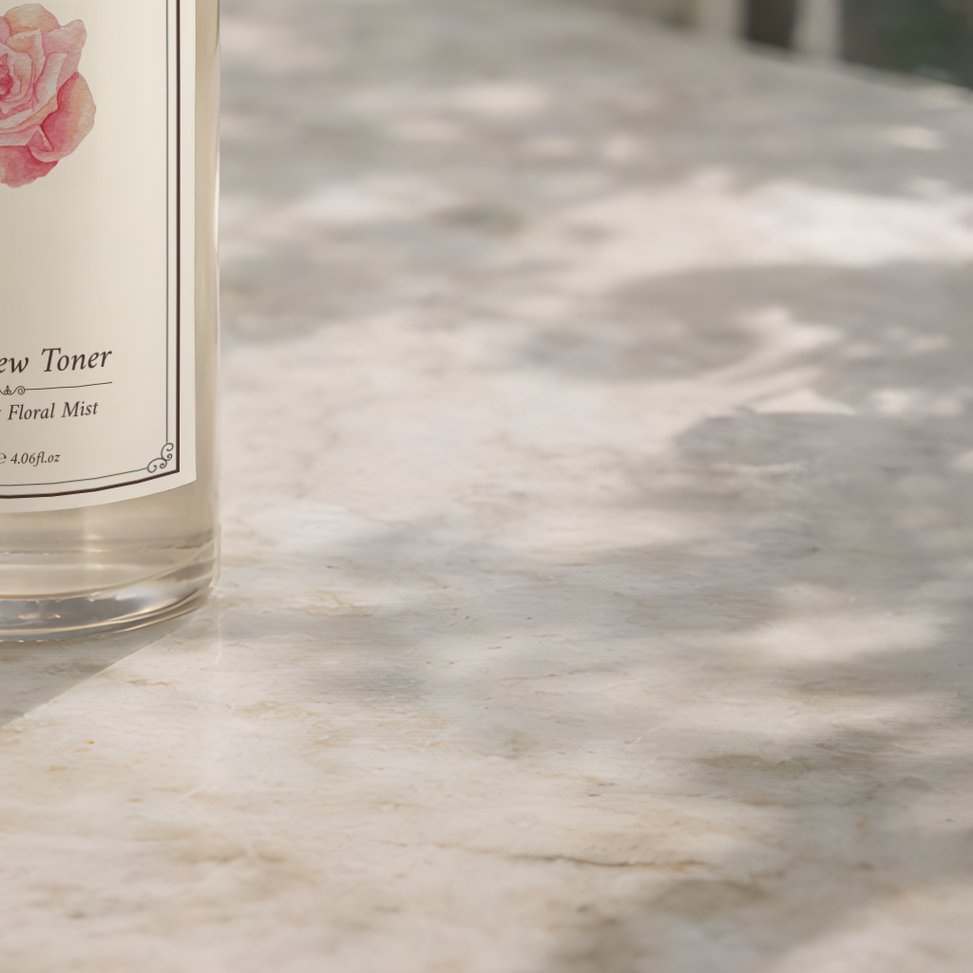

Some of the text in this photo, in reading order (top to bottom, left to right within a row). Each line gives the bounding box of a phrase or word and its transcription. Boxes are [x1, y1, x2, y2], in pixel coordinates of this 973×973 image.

[41, 347, 112, 373] Toner
[7, 402, 56, 421] Floral
[61, 400, 98, 418] Mist
[10, 451, 60, 467] 4.06fl.oz
